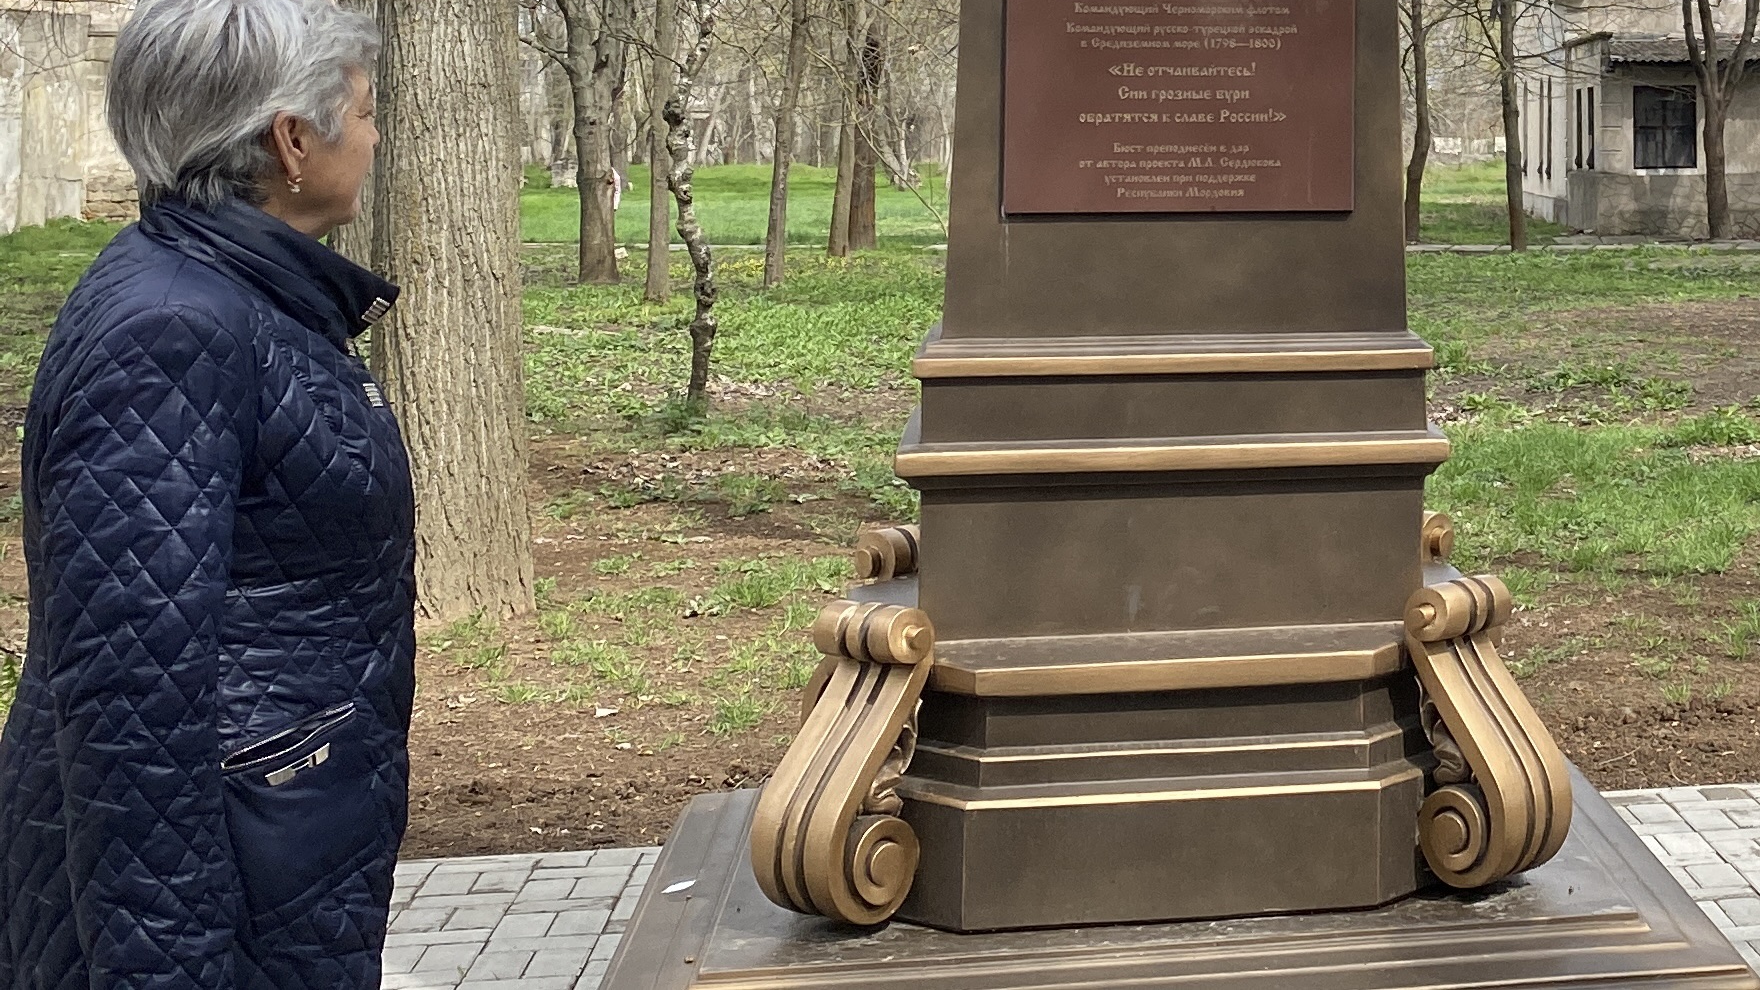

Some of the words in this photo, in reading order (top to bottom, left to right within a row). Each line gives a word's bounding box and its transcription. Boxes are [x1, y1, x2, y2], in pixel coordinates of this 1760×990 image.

[1074, 2, 1159, 16] Командующий
[1162, 3, 1243, 17] Черноморским
[1246, 4, 1290, 17] флотом
[1066, 22, 1150, 36] Командующий
[1153, 23, 1245, 37] русско-турецкой
[1248, 24, 1298, 36] эскадрой
[1091, 38, 1169, 50] Средиземном
[1172, 39, 1200, 51] море
[1108, 63, 1144, 77] «Не
[1148, 62, 1257, 78] отчаивайтесь!
[1118, 86, 1148, 100] Сии
[1151, 88, 1212, 103] грозные
[1079, 112, 1158, 126] обратятся
[1162, 113, 1171, 123] к
[1174, 112, 1215, 124] славе
[1219, 108, 1287, 124] России!»
[1113, 142, 1144, 153] Бюст
[1219, 145, 1227, 153] в
[1229, 145, 1249, 154] дар
[1079, 161, 1094, 169] от
[1096, 160, 1136, 170] автора
[1138, 160, 1185, 170] проекта
[1104, 174, 1170, 186] установлен
[1173, 175, 1193, 185] при
[1195, 174, 1256, 185] поддержке
[1116, 187, 1183, 200] Республики
[1185, 187, 1244, 199] Мордовия
